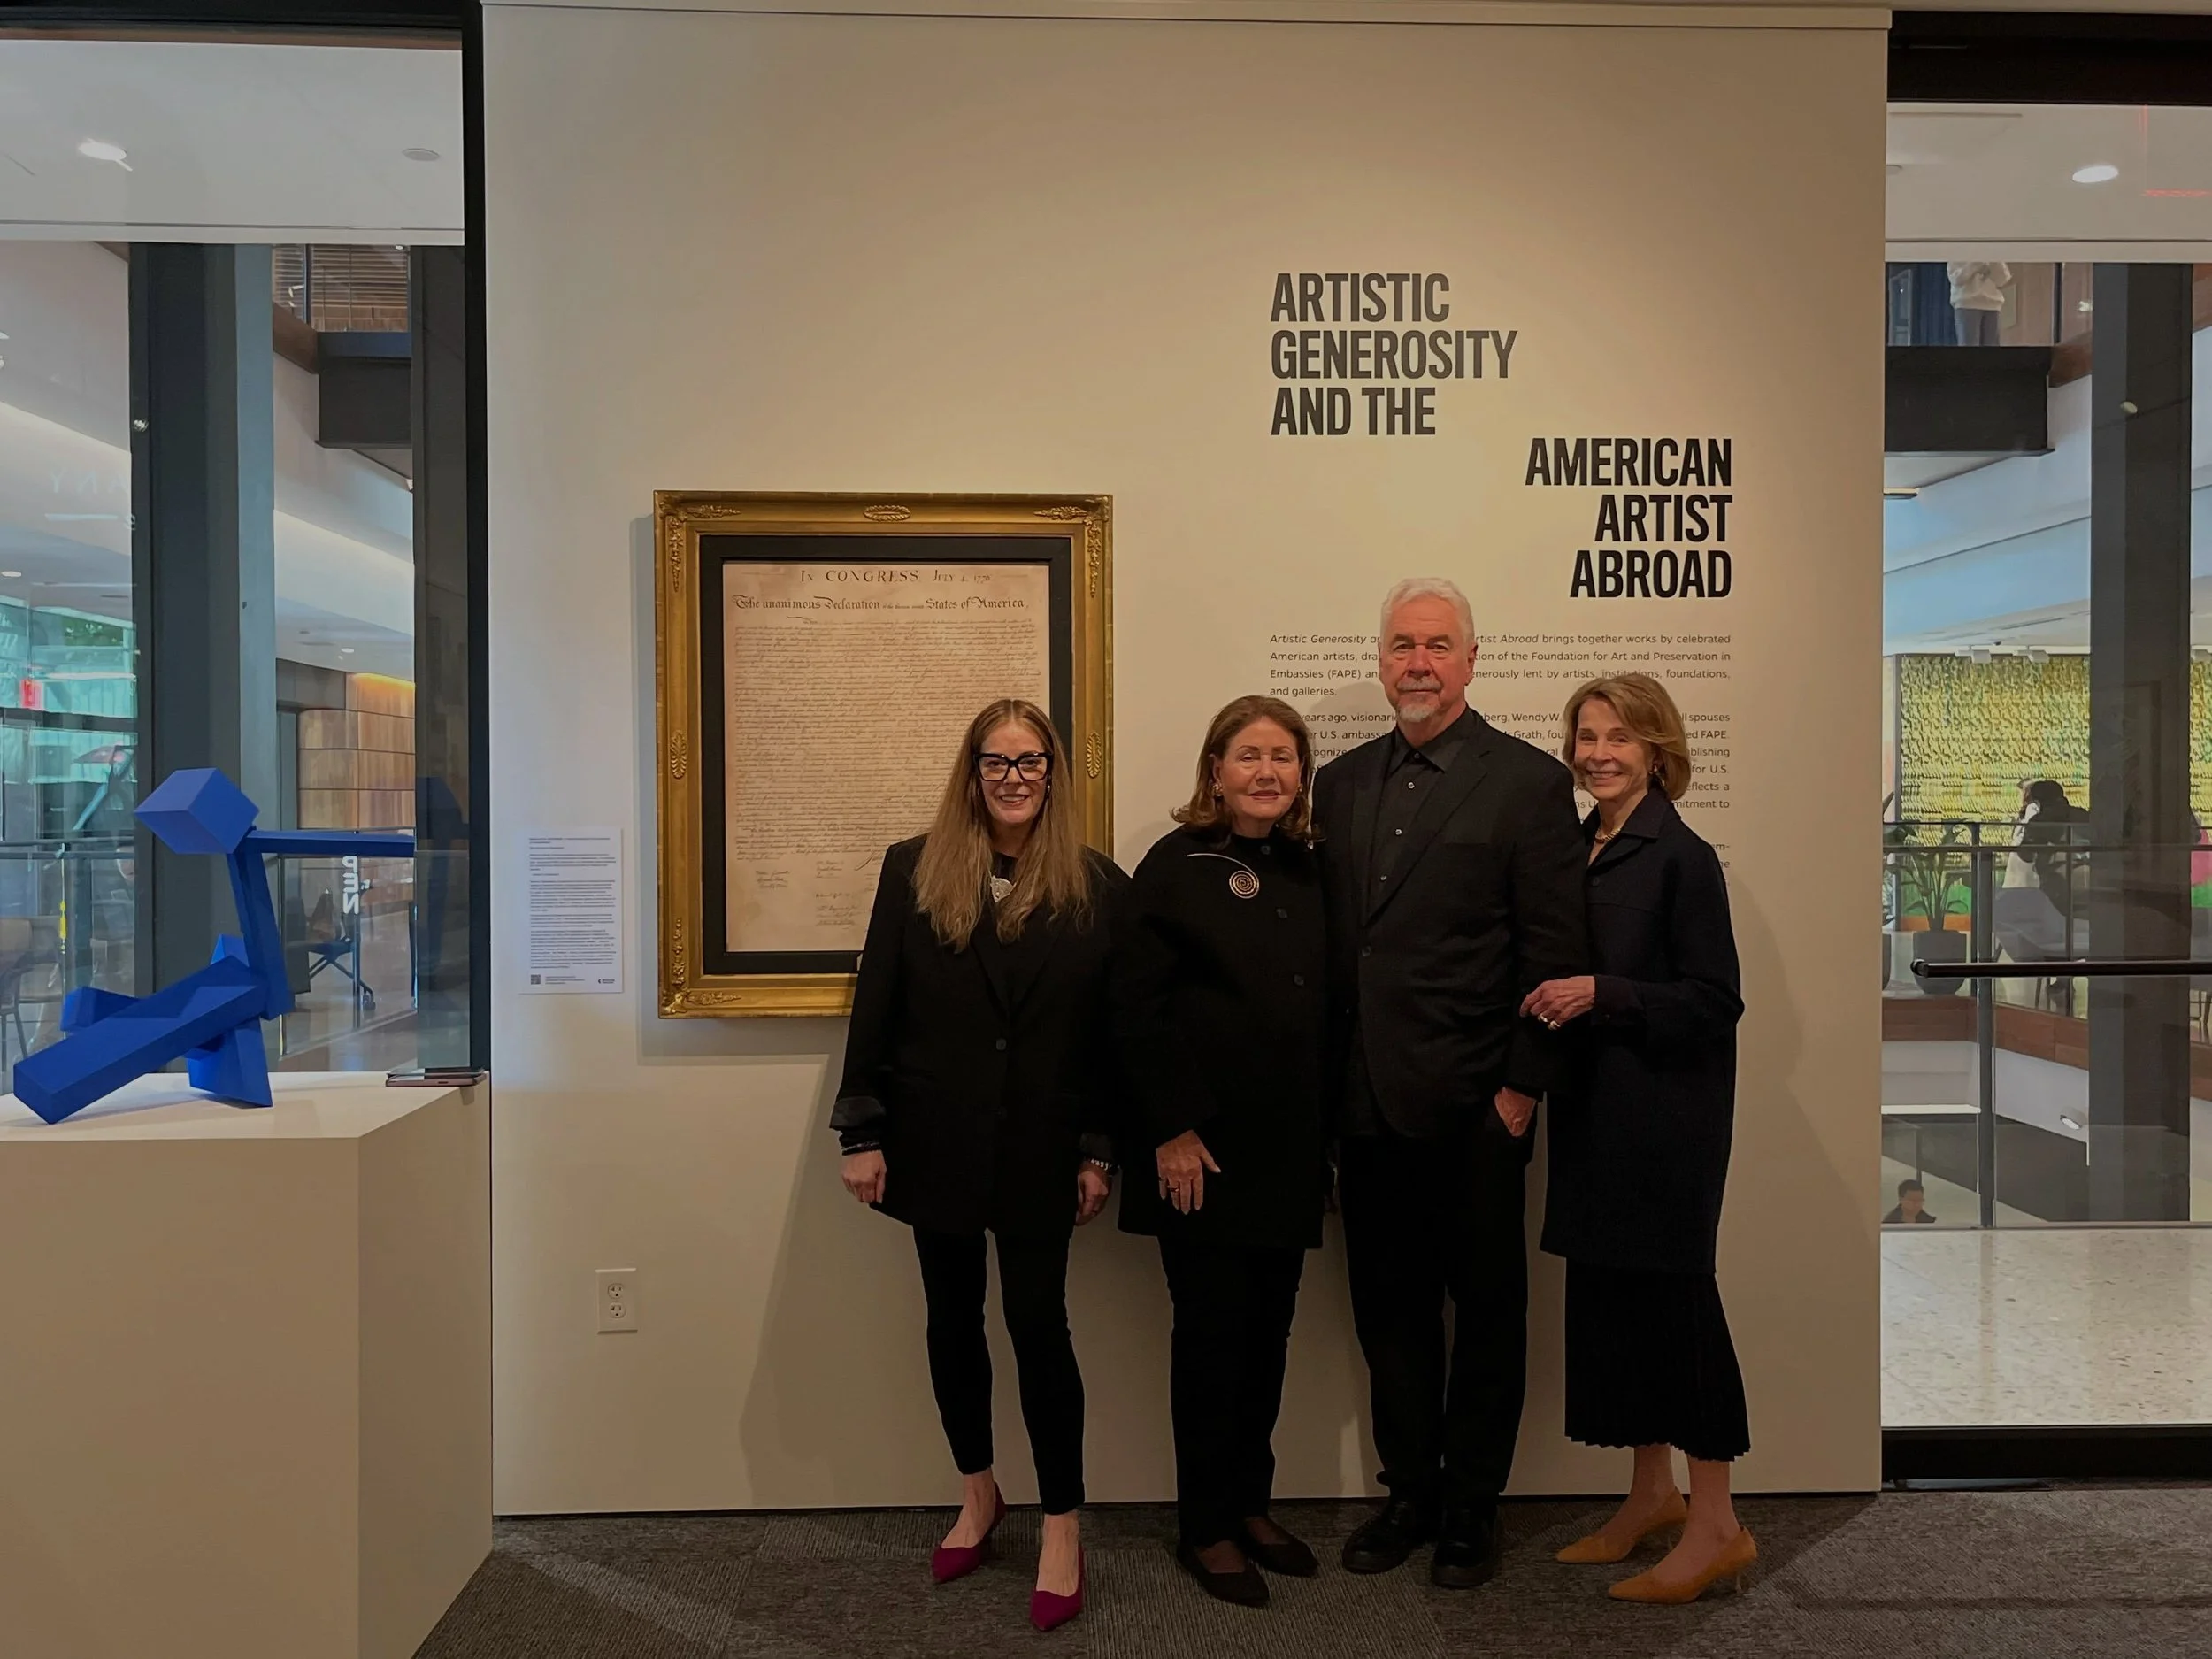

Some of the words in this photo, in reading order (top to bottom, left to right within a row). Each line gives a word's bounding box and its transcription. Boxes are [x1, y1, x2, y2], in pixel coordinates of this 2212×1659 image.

[1271, 273, 1449, 322] ARTISTIC
[1271, 330, 1517, 379] GENEROSITY
[1271, 388, 1351, 435] AND
[1362, 388, 1435, 435] THE
[1525, 438, 1731, 486] AMERICAN
[1595, 495, 1732, 542] ARTIST
[1571, 550, 1731, 597] ABROAD
[926, 597, 957, 610] States
[1270, 634, 1307, 643] Artistic
[1310, 634, 1367, 644] Generosity
[1475, 634, 1496, 643] rtist
[1500, 634, 1539, 643] Abroad
[1542, 634, 1574, 645] brings
[1578, 634, 1622, 645] together
[1626, 634, 1657, 643] works
[1660, 634, 1672, 644] by
[1677, 634, 1731, 643] celebrated
[1270, 652, 1319, 661] American
[1497, 651, 1508, 661] of
[1511, 652, 1528, 661] the
[1532, 652, 1590, 661] Foundation
[1593, 651, 1608, 661] for
[1611, 652, 1627, 661] Art
[1631, 652, 1650, 661] and
[1654, 652, 1718, 661] Preservation
[1721, 652, 1731, 661] in
[1270, 670, 1324, 679] Embassies
[1327, 669, 1362, 680] (FAPE)
[1523, 670, 1542, 679] lent
[1547, 670, 1559, 680] by
[1270, 687, 1289, 695] and
[1292, 687, 1337, 697] galleries.
[1328, 715, 1348, 724] ago,
[1511, 713, 1548, 723] Wendy
[1689, 714, 1731, 723] spouses
[1688, 747, 1731, 758] blishing
[1692, 764, 1706, 773] for
